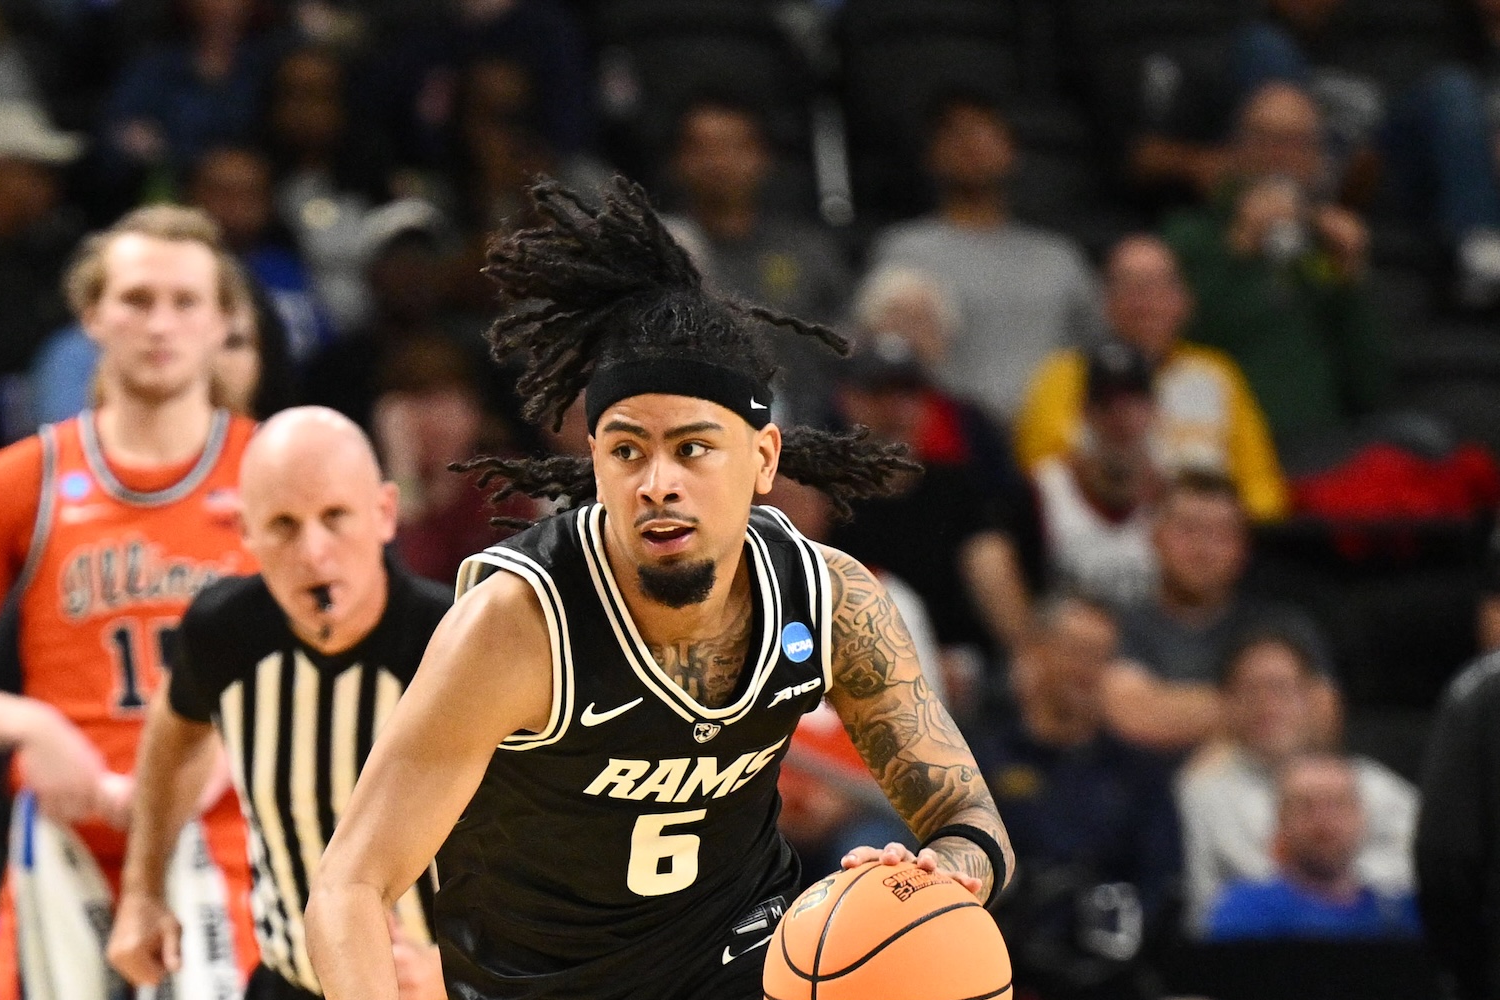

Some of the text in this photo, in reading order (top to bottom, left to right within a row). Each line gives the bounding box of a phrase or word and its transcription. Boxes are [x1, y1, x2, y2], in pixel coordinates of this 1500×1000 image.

[786, 638, 814, 655] NCAA
[583, 735, 789, 803] RAMS
[626, 808, 708, 897] 6
